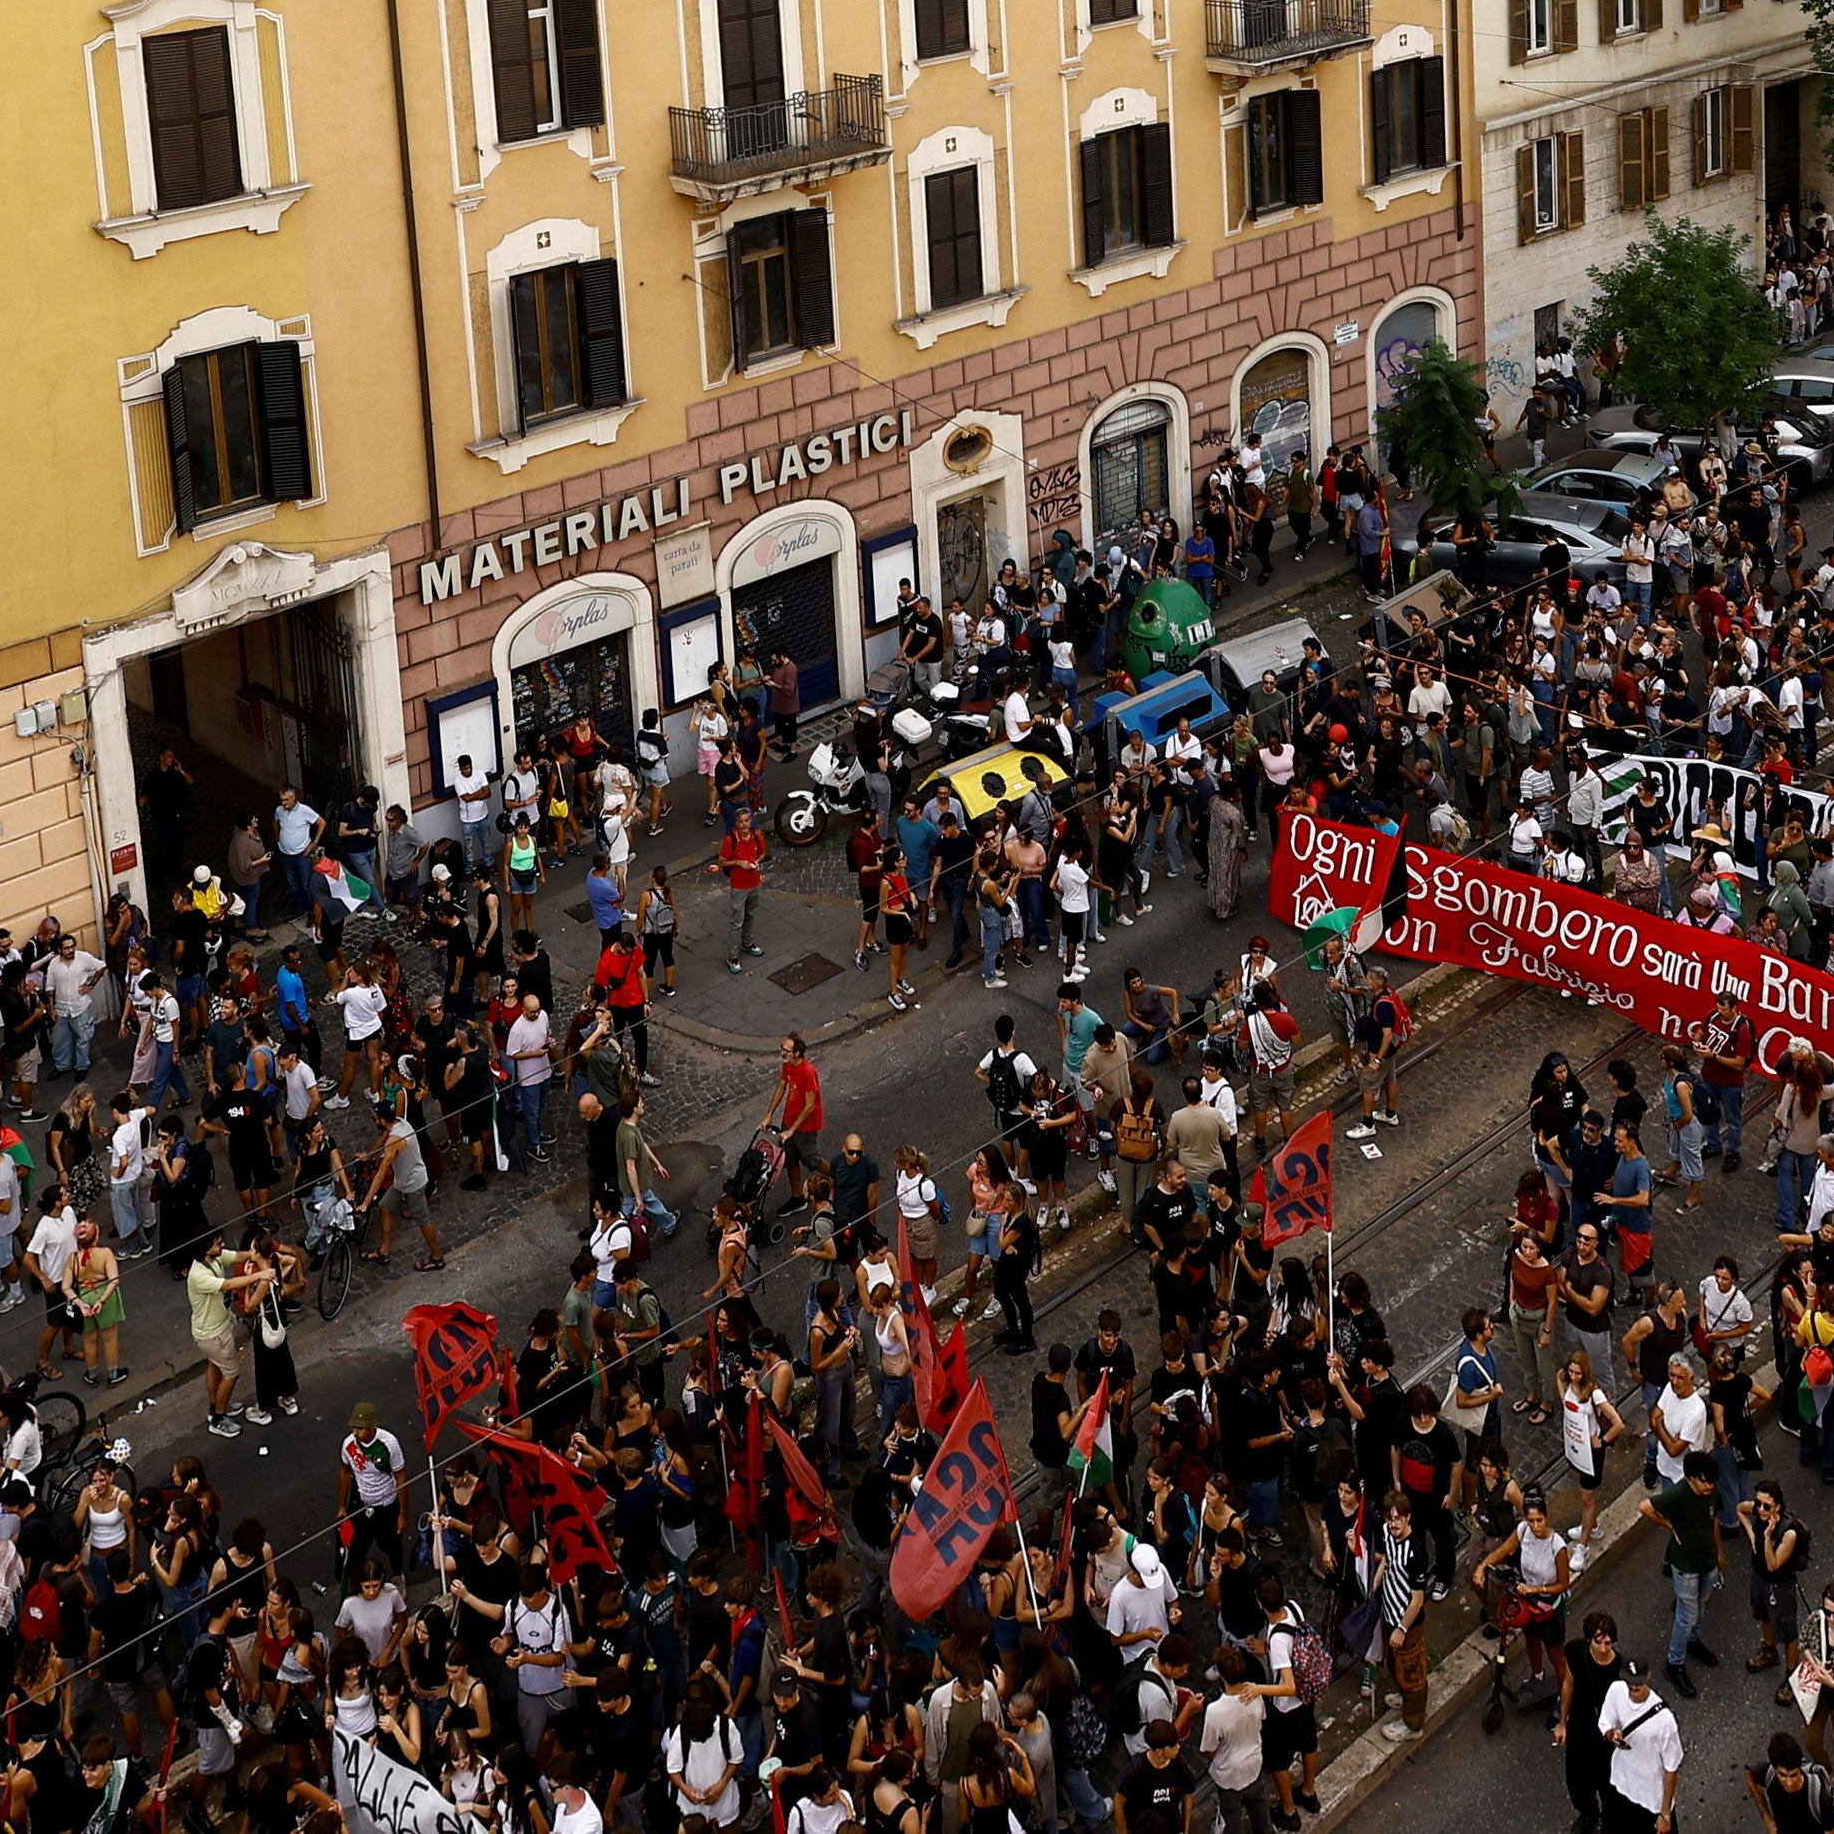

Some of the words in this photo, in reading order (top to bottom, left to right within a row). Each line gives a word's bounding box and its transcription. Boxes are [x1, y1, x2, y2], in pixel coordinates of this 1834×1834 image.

[420, 478, 690, 605] MATERIALI
[720, 410, 914, 504] PLASTICI
[664, 547, 687, 561] carta
[689, 541, 701, 553] da
[670, 557, 699, 576] parati
[114, 830, 127, 843] 52
[1290, 813, 1376, 885] Ogni
[1405, 845, 1640, 969] Sgombero
[1641, 939, 1704, 990] sarà
[1385, 914, 1437, 953] on
[1468, 920, 1636, 1011] Fabrizio
[1658, 1007, 1703, 1039] ne
[1706, 1023, 1729, 1055] 77
